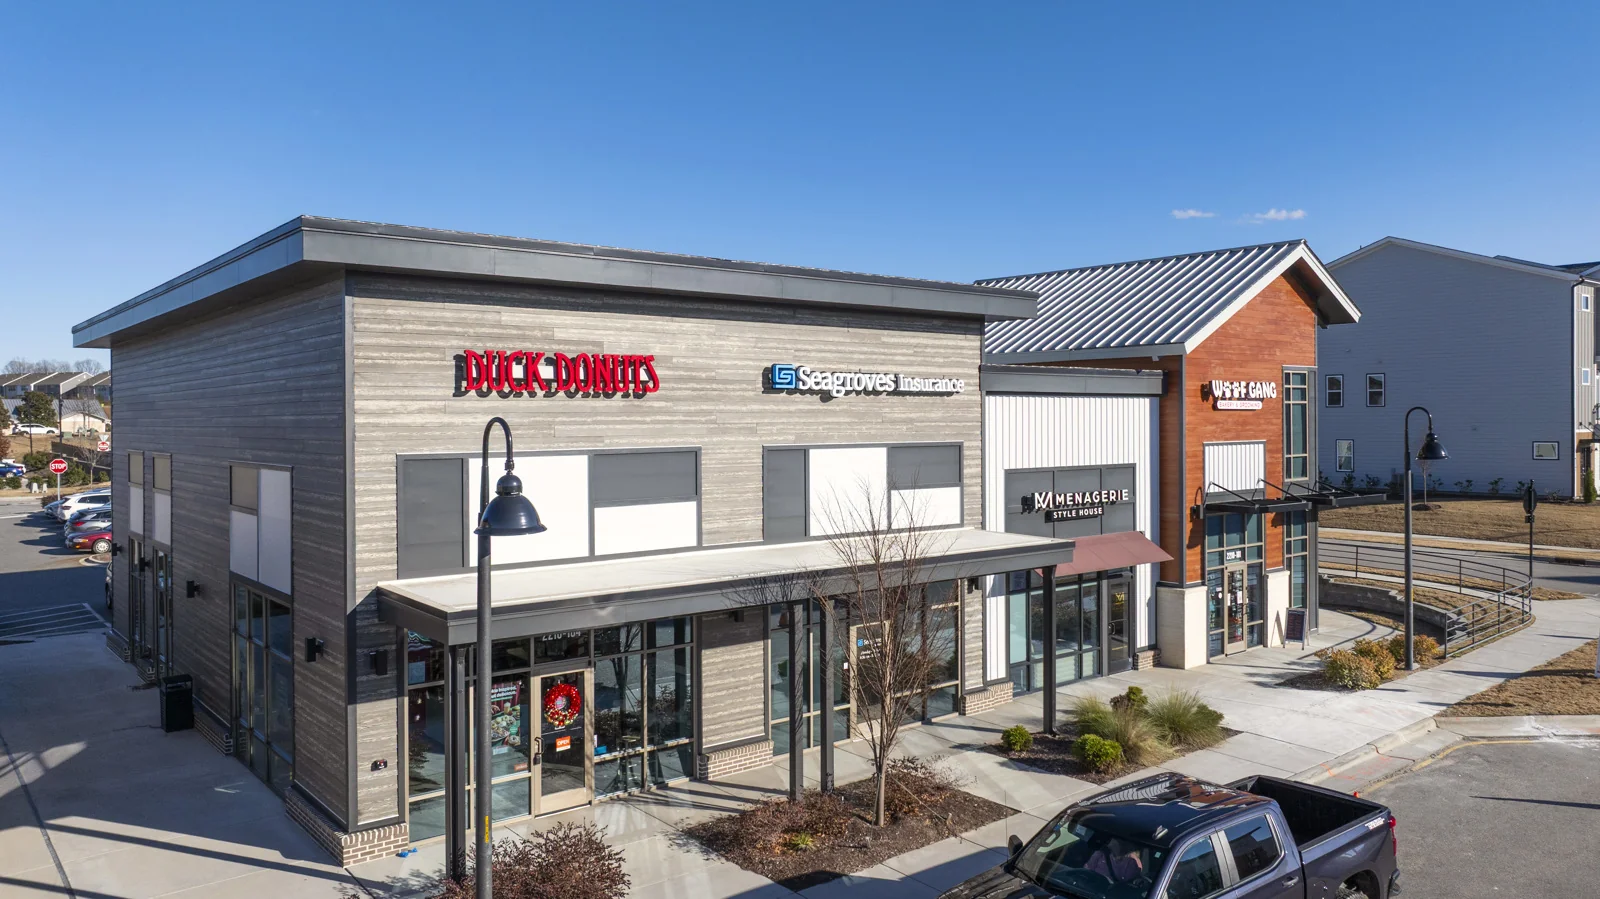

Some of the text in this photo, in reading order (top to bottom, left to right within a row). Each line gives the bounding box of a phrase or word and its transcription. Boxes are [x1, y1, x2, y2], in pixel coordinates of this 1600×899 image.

[464, 350, 660, 393] DUCK DONUTS
[797, 366, 965, 398] Seagroves Insurance
[1249, 381, 1277, 398] GANG
[1055, 489, 1129, 505] MENAGERIE
[1053, 507, 1103, 519] STYLE HOUSE
